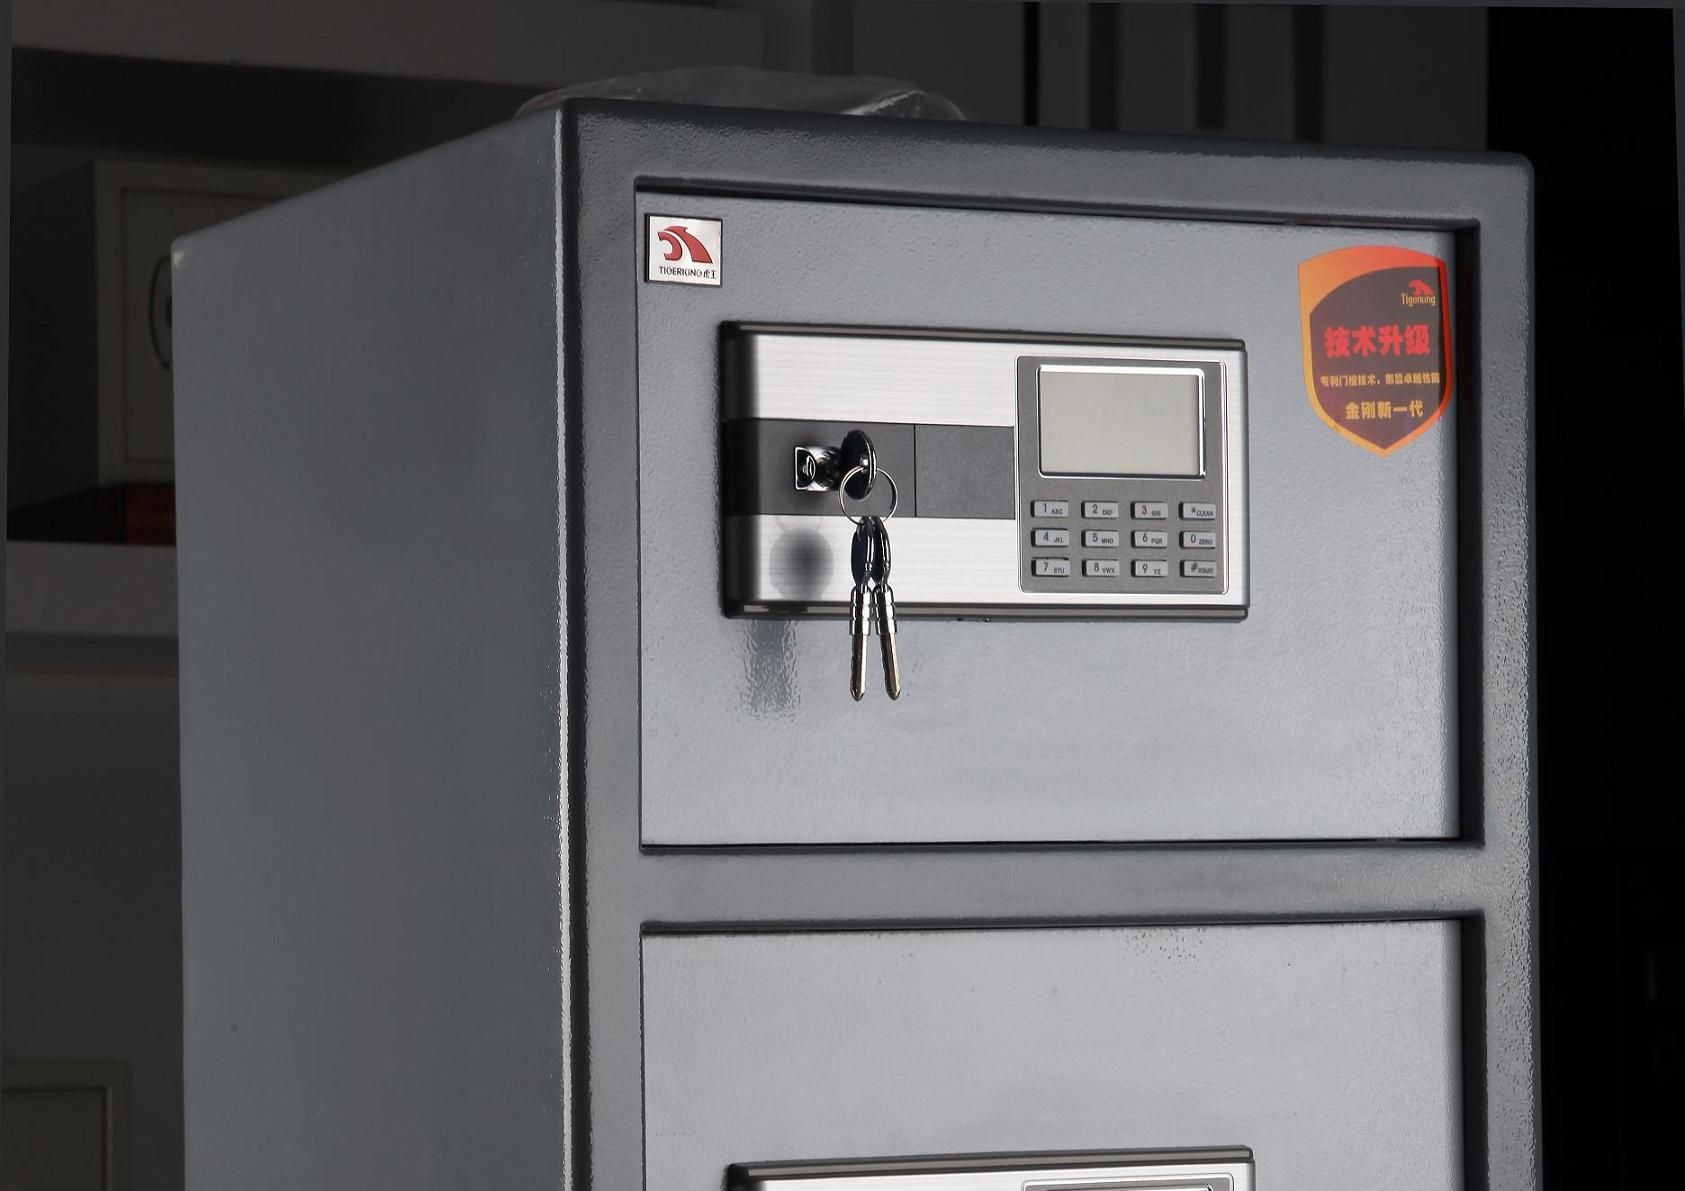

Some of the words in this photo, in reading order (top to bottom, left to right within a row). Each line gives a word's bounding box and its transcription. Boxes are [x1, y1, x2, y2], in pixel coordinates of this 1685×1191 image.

[1324, 325, 1431, 357] 技术升级
[1345, 401, 1424, 420] 金刚新一代
